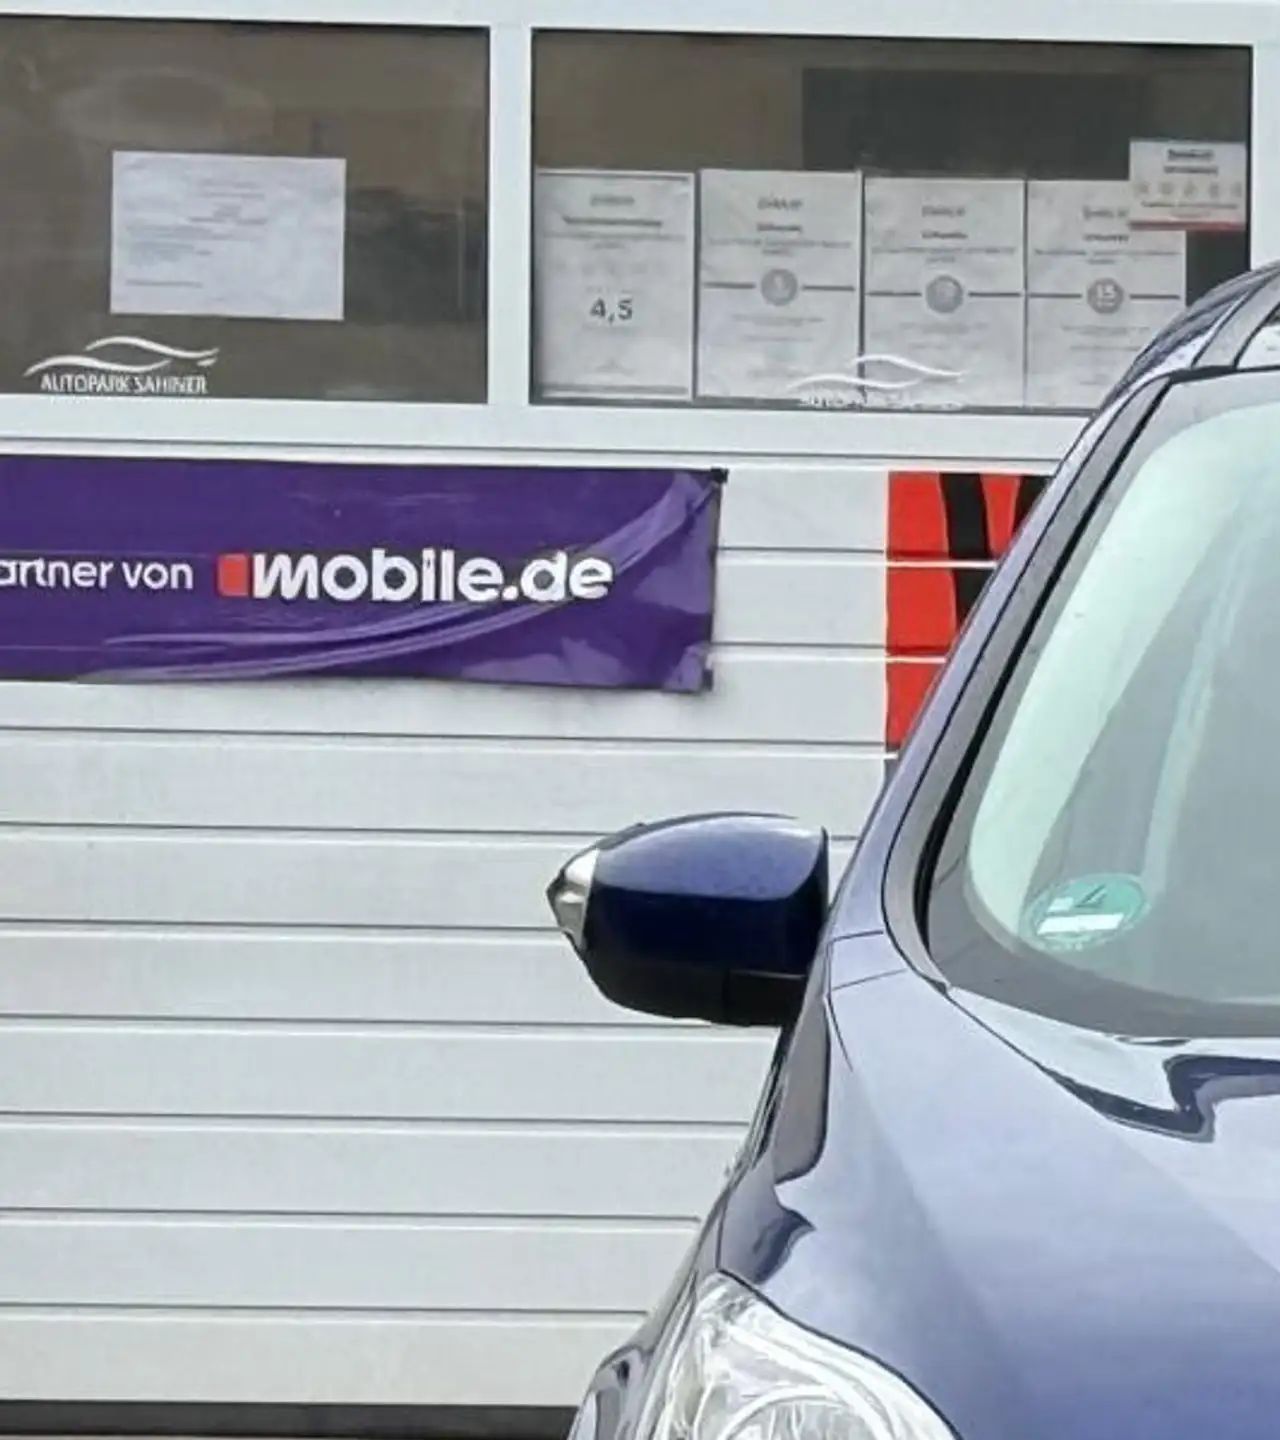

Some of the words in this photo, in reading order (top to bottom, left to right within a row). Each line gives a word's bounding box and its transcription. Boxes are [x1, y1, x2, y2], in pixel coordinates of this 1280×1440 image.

[589, 297, 633, 324] 4,5
[40, 373, 129, 392] AUTOPARK
[122, 560, 193, 589] von
[251, 548, 614, 602] mobile.de
